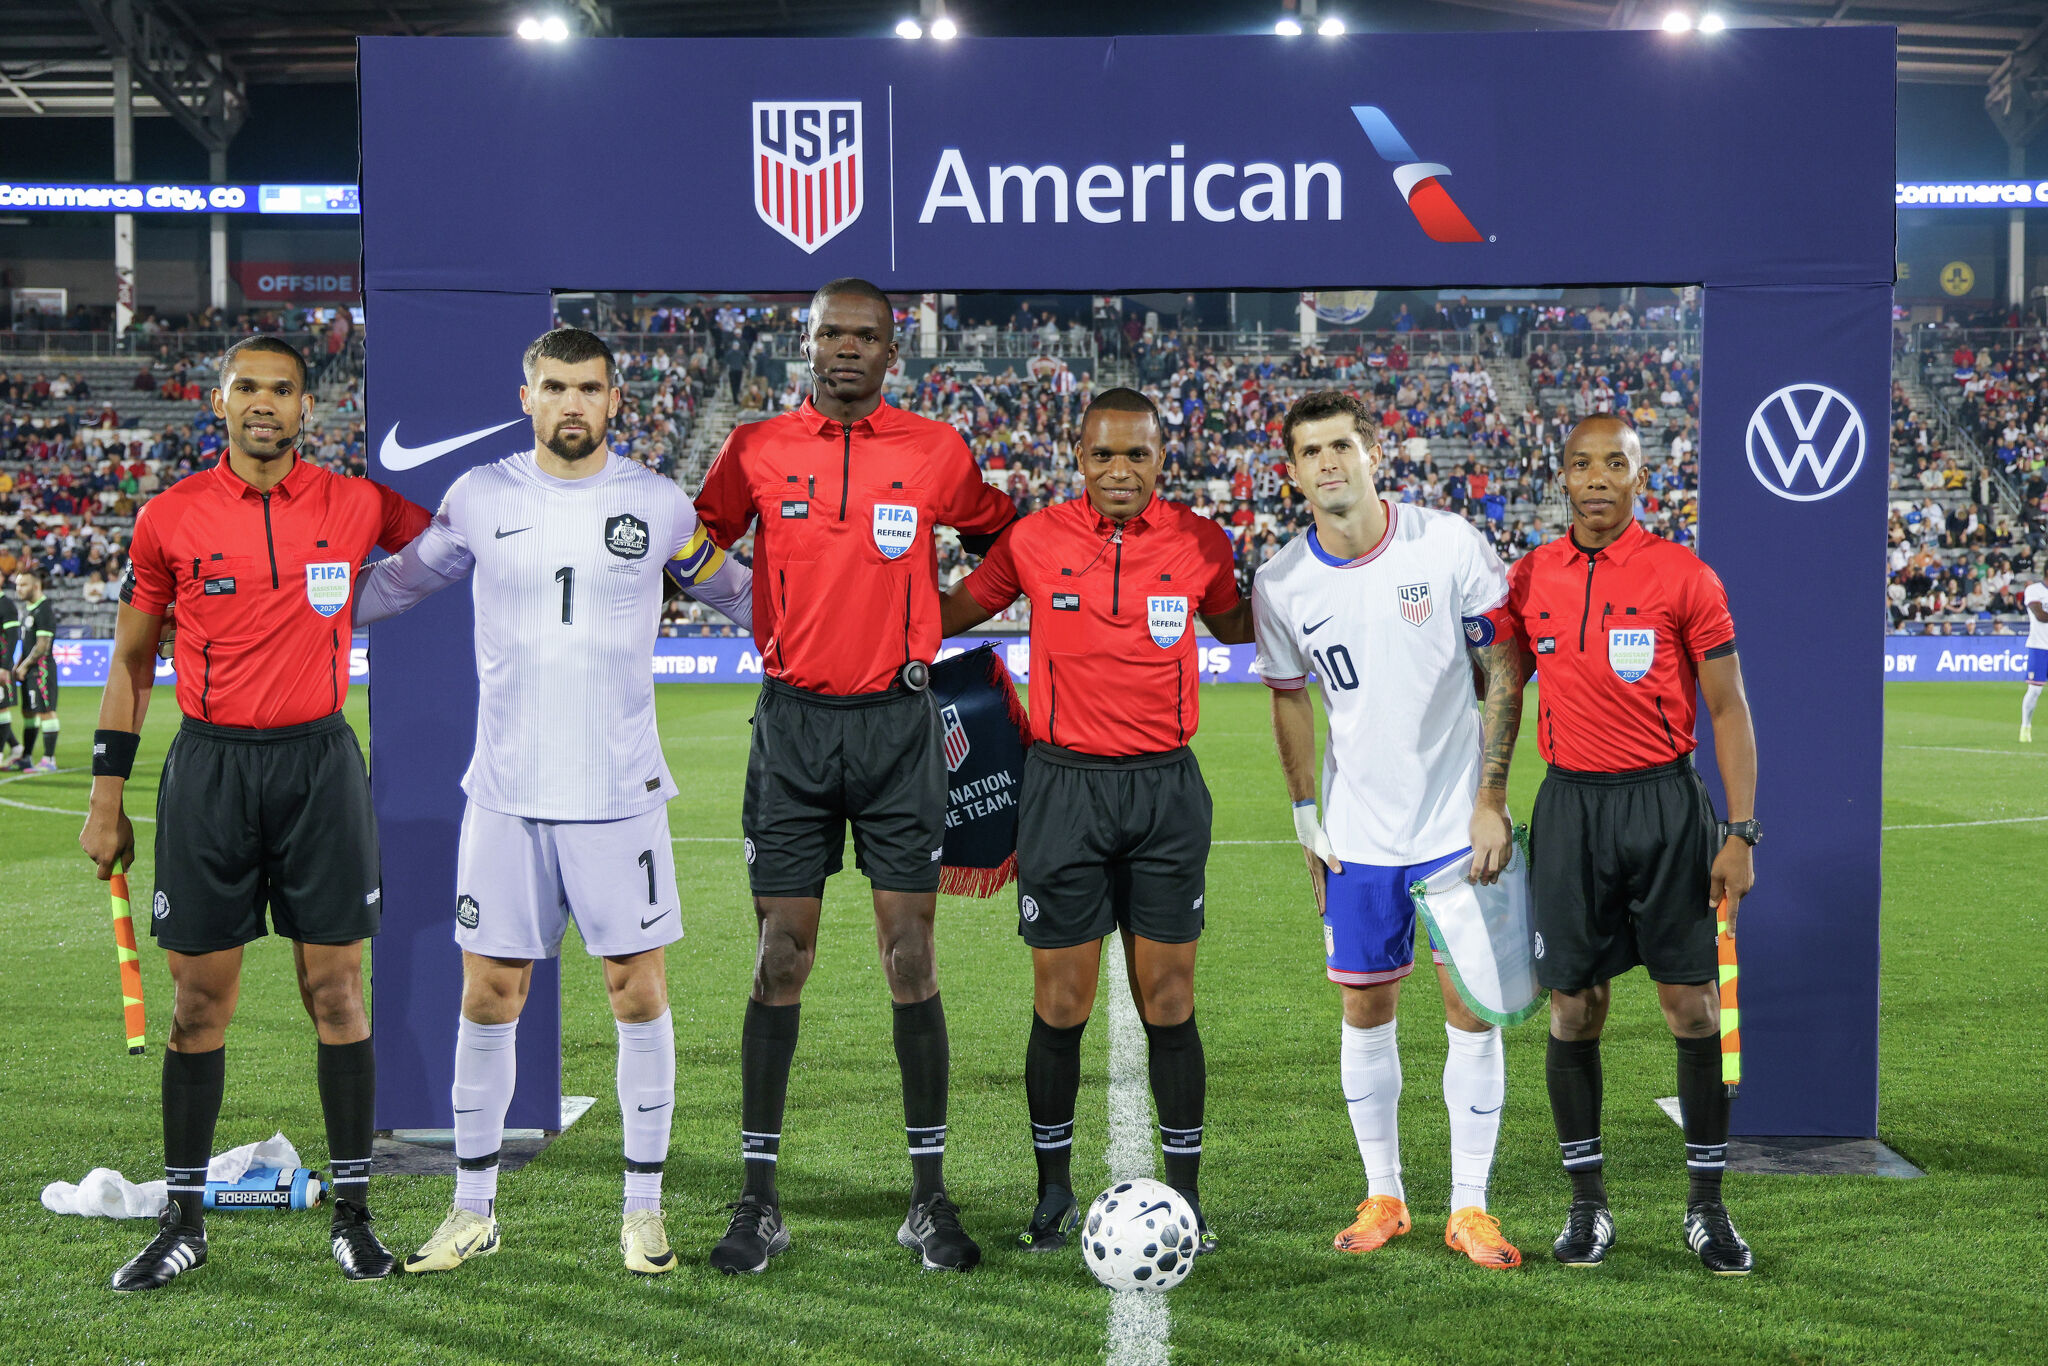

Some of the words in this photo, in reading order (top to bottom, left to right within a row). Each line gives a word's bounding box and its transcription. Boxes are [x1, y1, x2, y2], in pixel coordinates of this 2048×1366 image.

[760, 109, 855, 166] USA
[918, 144, 1342, 224] American
[209, 187, 246, 208] CO
[258, 275, 352, 292] OFFSIDE
[877, 507, 914, 523] FIFA
[876, 528, 912, 538] REFEREE
[884, 546, 902, 554] 2025
[311, 566, 347, 580] FIFA
[555, 566, 575, 625] 1
[1400, 585, 1428, 603] USA
[1151, 599, 1185, 613] FIFA
[1151, 619, 1183, 628] REFEREE
[1158, 636, 1175, 644] 2025
[1612, 633, 1650, 646] FIFA
[697, 655, 718, 674] BY
[1313, 644, 1360, 692] 10
[1896, 654, 1917, 672] BY
[1622, 671, 1640, 679] 2025
[949, 769, 1017, 806] NATION.
[963, 790, 1017, 821] TEAM.
[638, 849, 658, 906] 1
[218, 1192, 289, 1204] POWERADE
